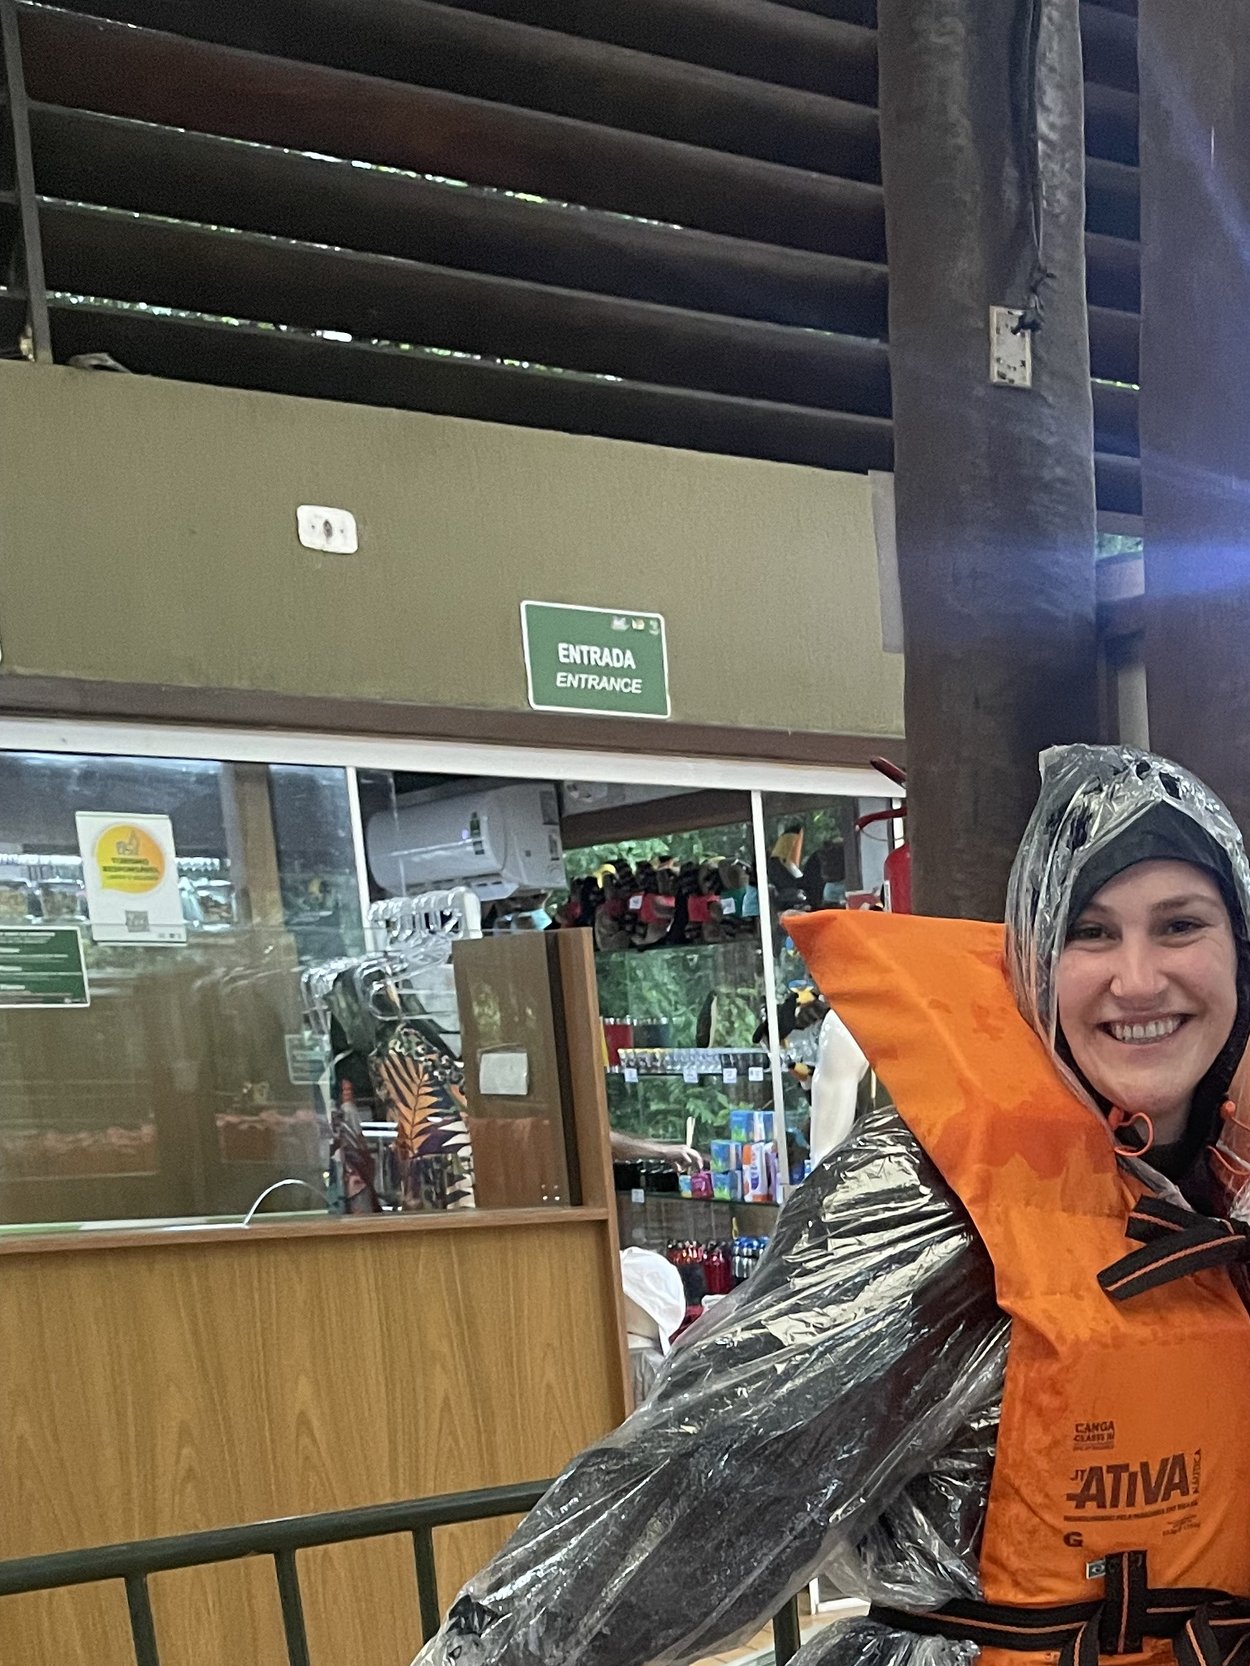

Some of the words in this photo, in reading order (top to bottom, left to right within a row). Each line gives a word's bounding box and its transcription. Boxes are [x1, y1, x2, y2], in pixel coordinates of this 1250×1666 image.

[557, 642, 637, 670] ENTRADA
[556, 672, 643, 694] ENTRANCE
[1066, 1453, 1190, 1510] ATIVA
[1070, 1469, 1087, 1482] JT
[1063, 1531, 1083, 1548] G
